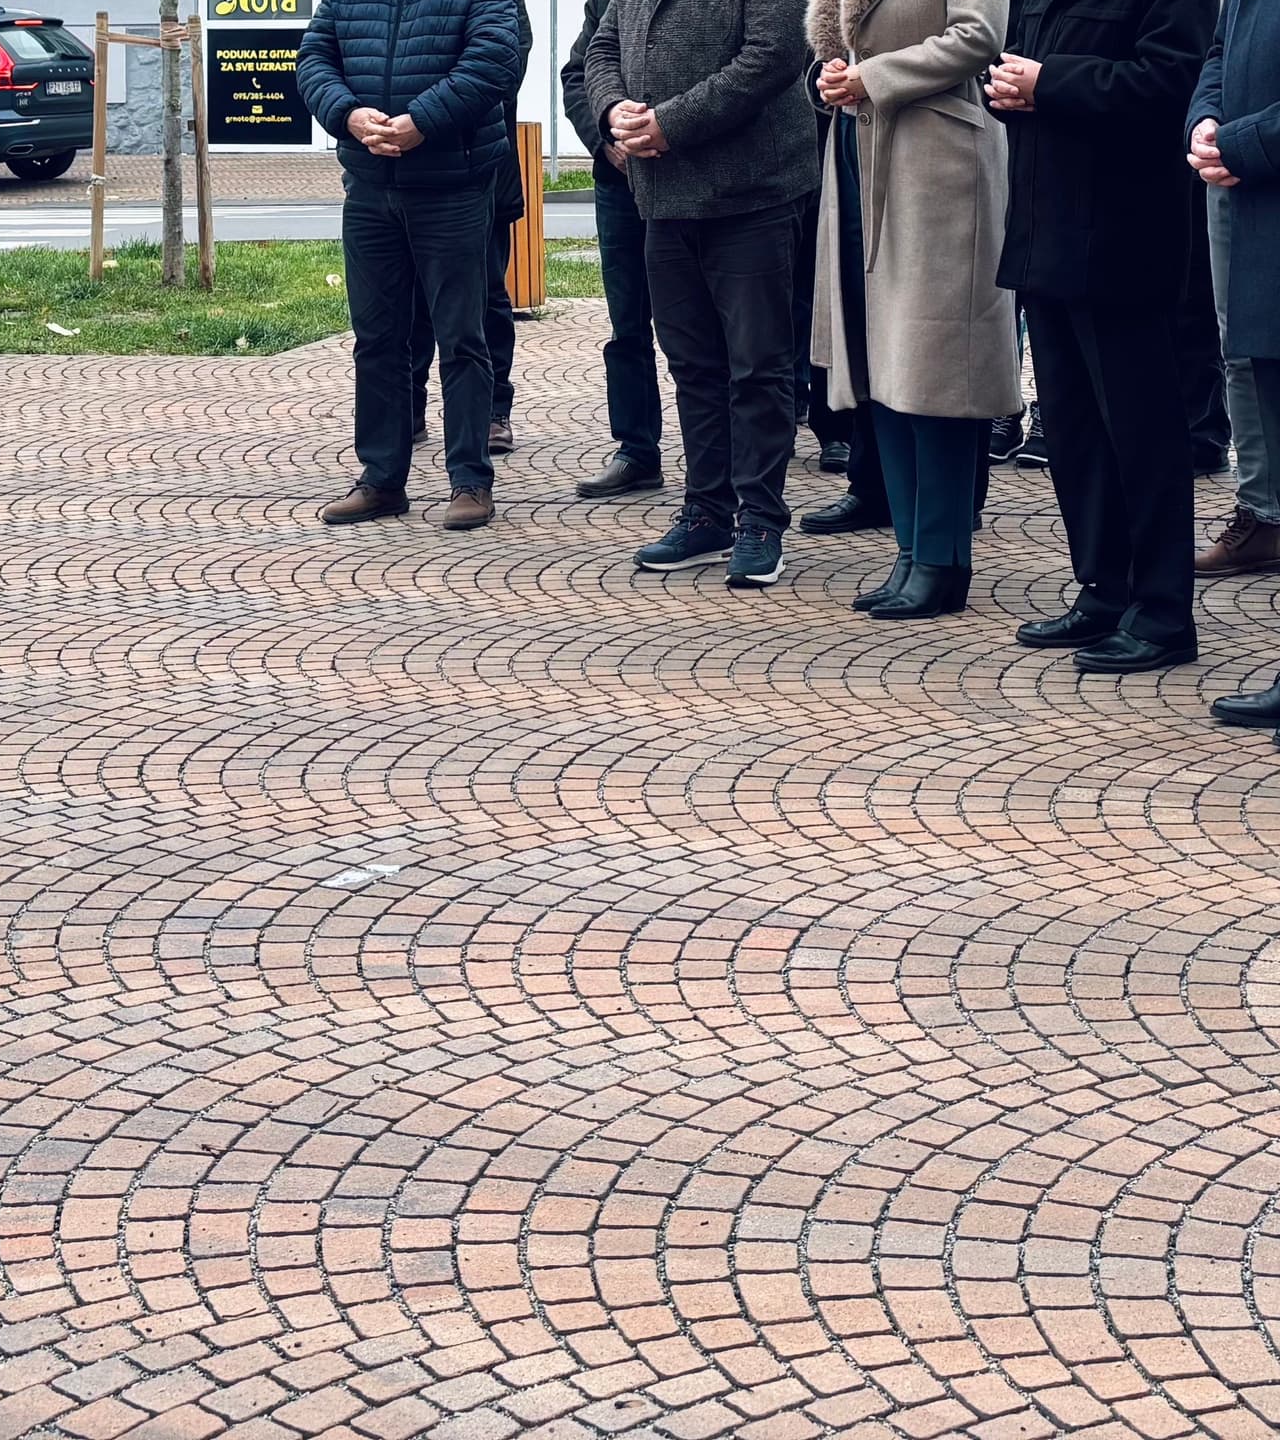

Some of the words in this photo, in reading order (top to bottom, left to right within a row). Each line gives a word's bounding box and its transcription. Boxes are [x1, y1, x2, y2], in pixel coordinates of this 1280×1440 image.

[216, 49, 257, 59] PODUKA
[258, 49, 268, 59] IZ
[220, 62, 234, 71] ZA
[235, 62, 255, 71] SVE
